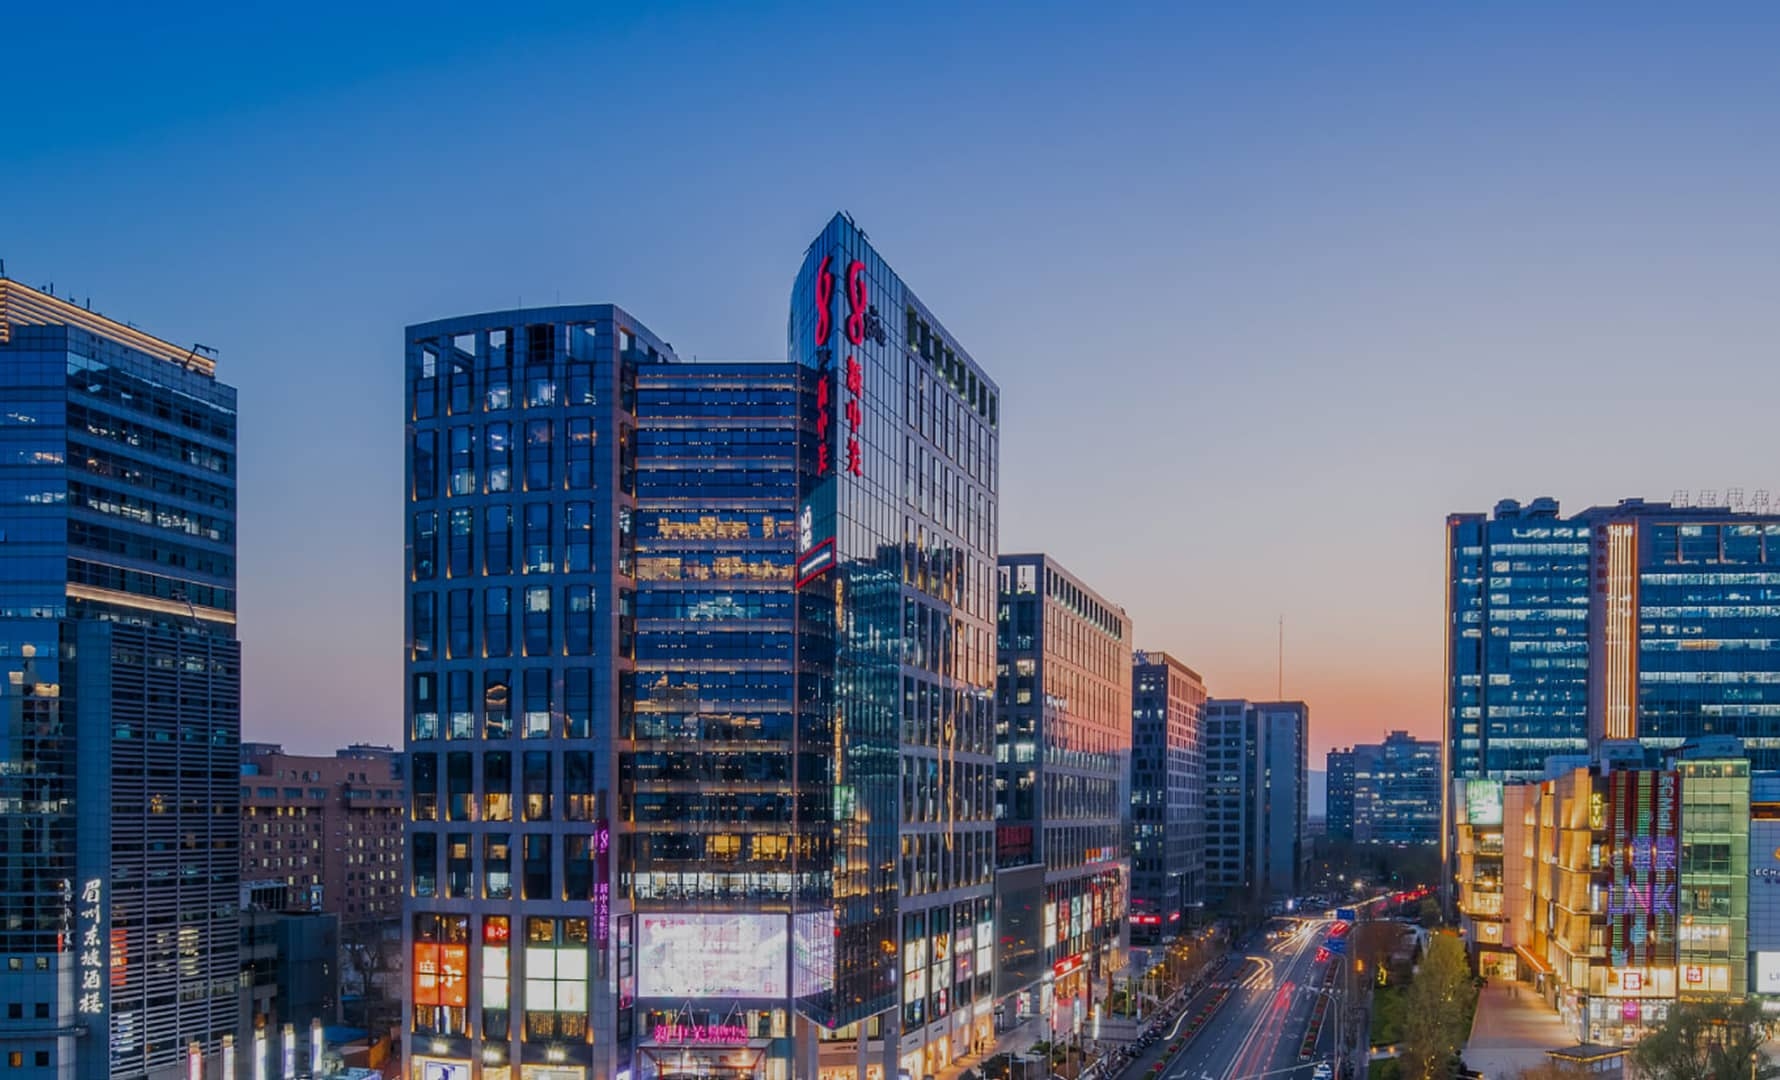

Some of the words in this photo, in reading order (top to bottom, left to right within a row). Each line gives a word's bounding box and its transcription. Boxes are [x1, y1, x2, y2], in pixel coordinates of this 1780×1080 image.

[1592, 793, 1602, 827] KTV
[79, 878, 103, 1013] 眉州东坡酒楼
